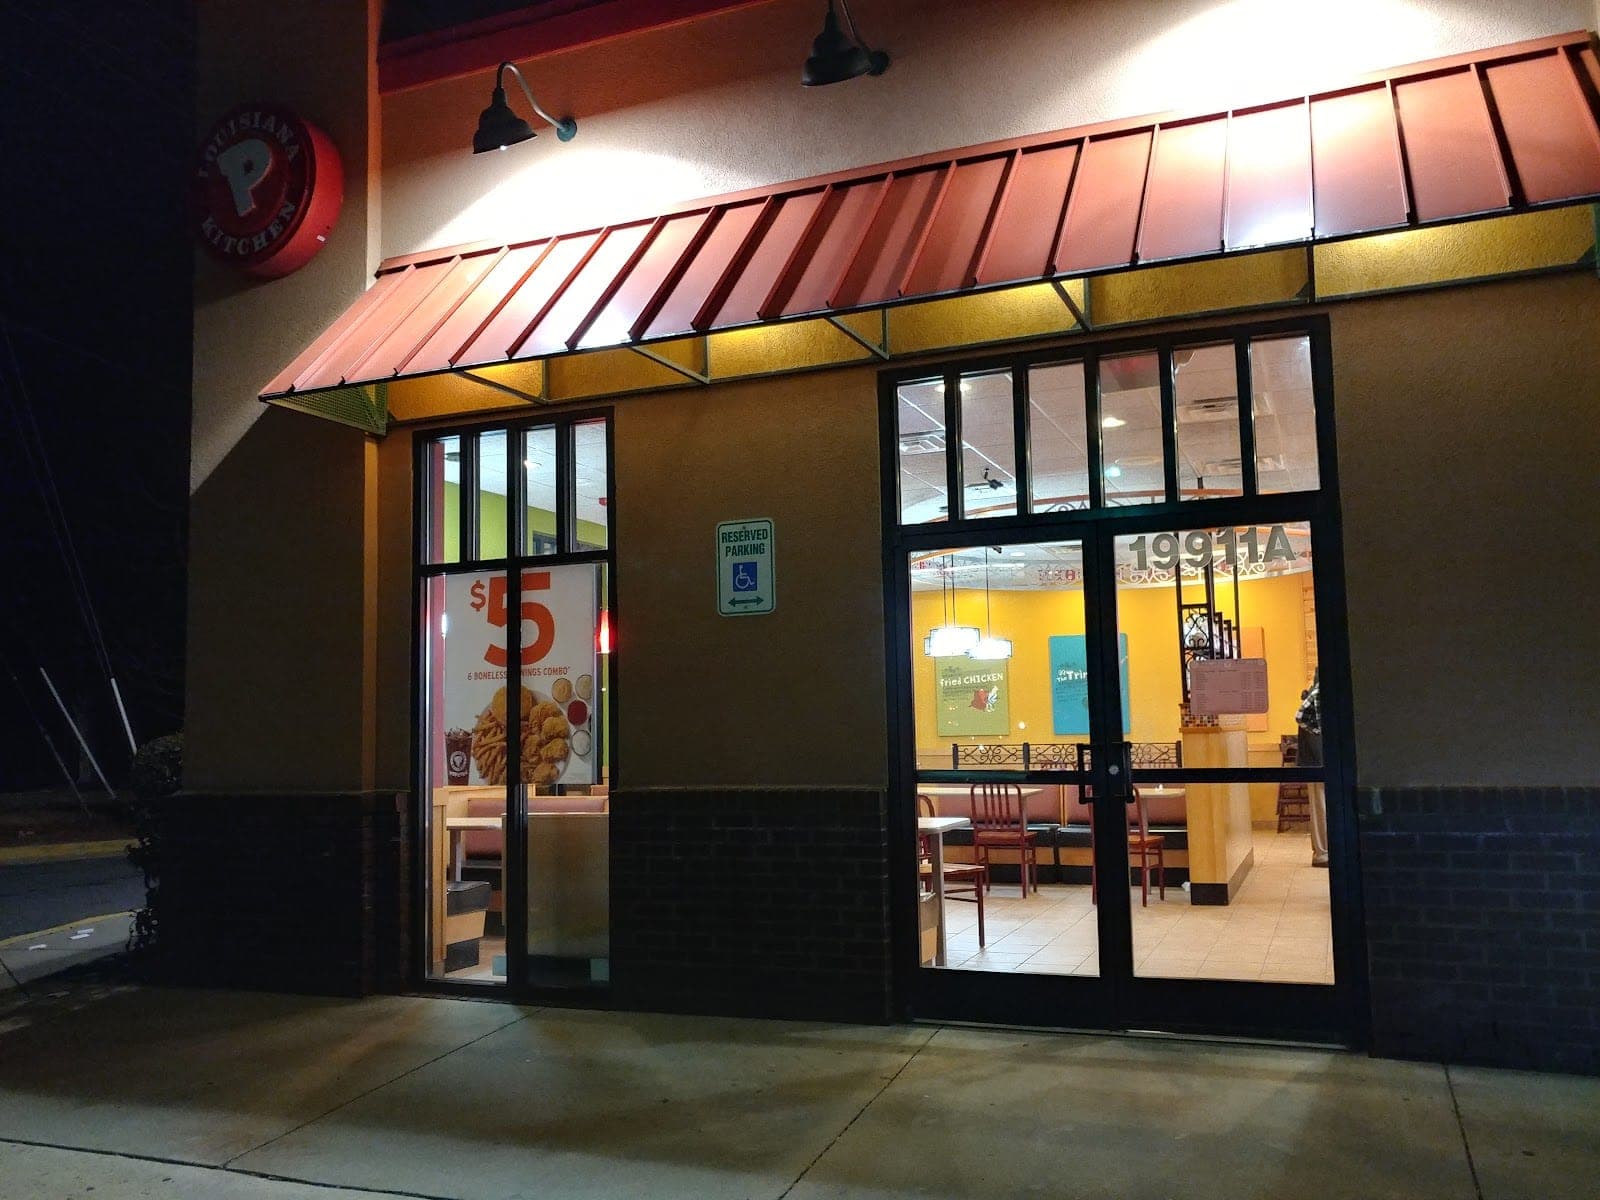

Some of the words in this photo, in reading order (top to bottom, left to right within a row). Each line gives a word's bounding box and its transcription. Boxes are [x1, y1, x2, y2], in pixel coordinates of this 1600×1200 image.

[202, 201, 296, 255] KITCHEN
[721, 528, 768, 543] RESERVED
[725, 542, 765, 557] PARKING
[1128, 525, 1297, 570] 19911A
[467, 672, 472, 680] 6
[963, 672, 1004, 684] CHICKEN
